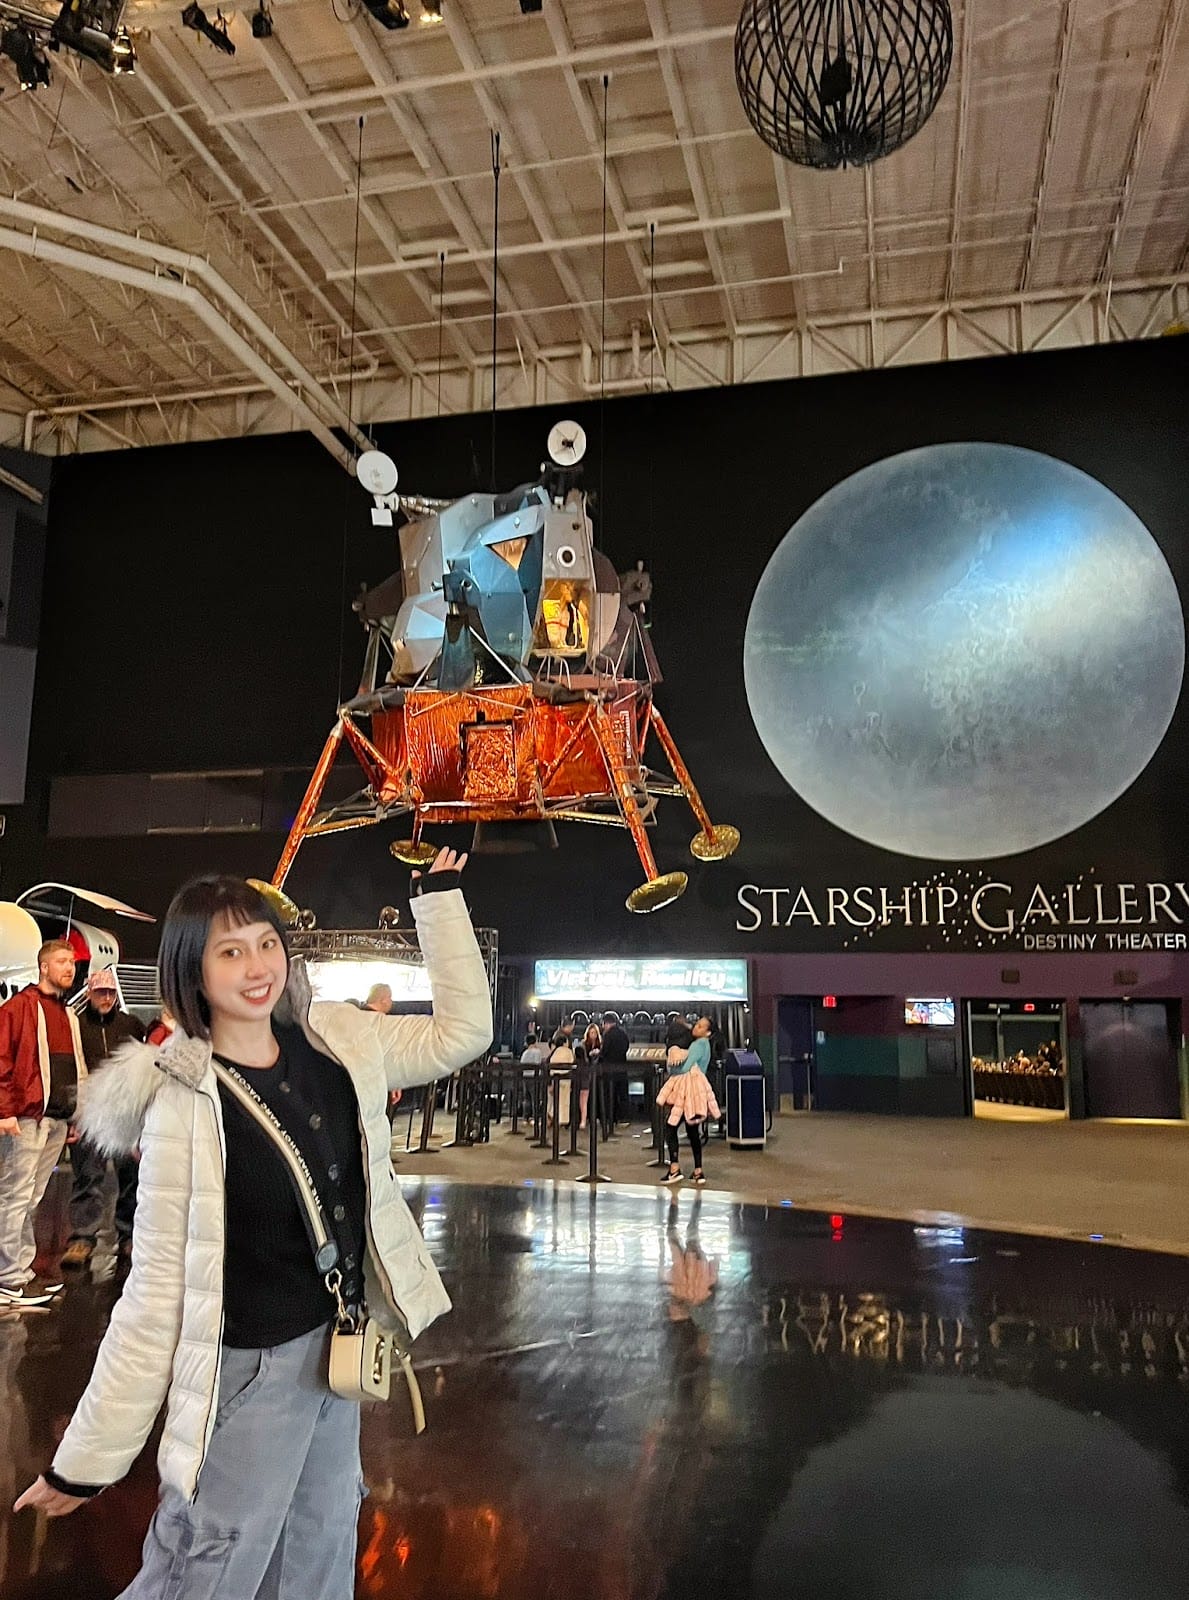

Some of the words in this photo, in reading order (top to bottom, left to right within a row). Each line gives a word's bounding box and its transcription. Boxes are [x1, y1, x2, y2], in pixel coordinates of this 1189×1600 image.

[736, 884, 959, 932] STARSHIP
[1023, 932, 1097, 950] DESTINY
[1105, 932, 1187, 950] THEATER
[228, 1066, 262, 1103] JACOBS
[260, 1102, 281, 1128] MARC
[281, 1130, 314, 1186] SNAPSHOT
[311, 1187, 323, 1212] THE
